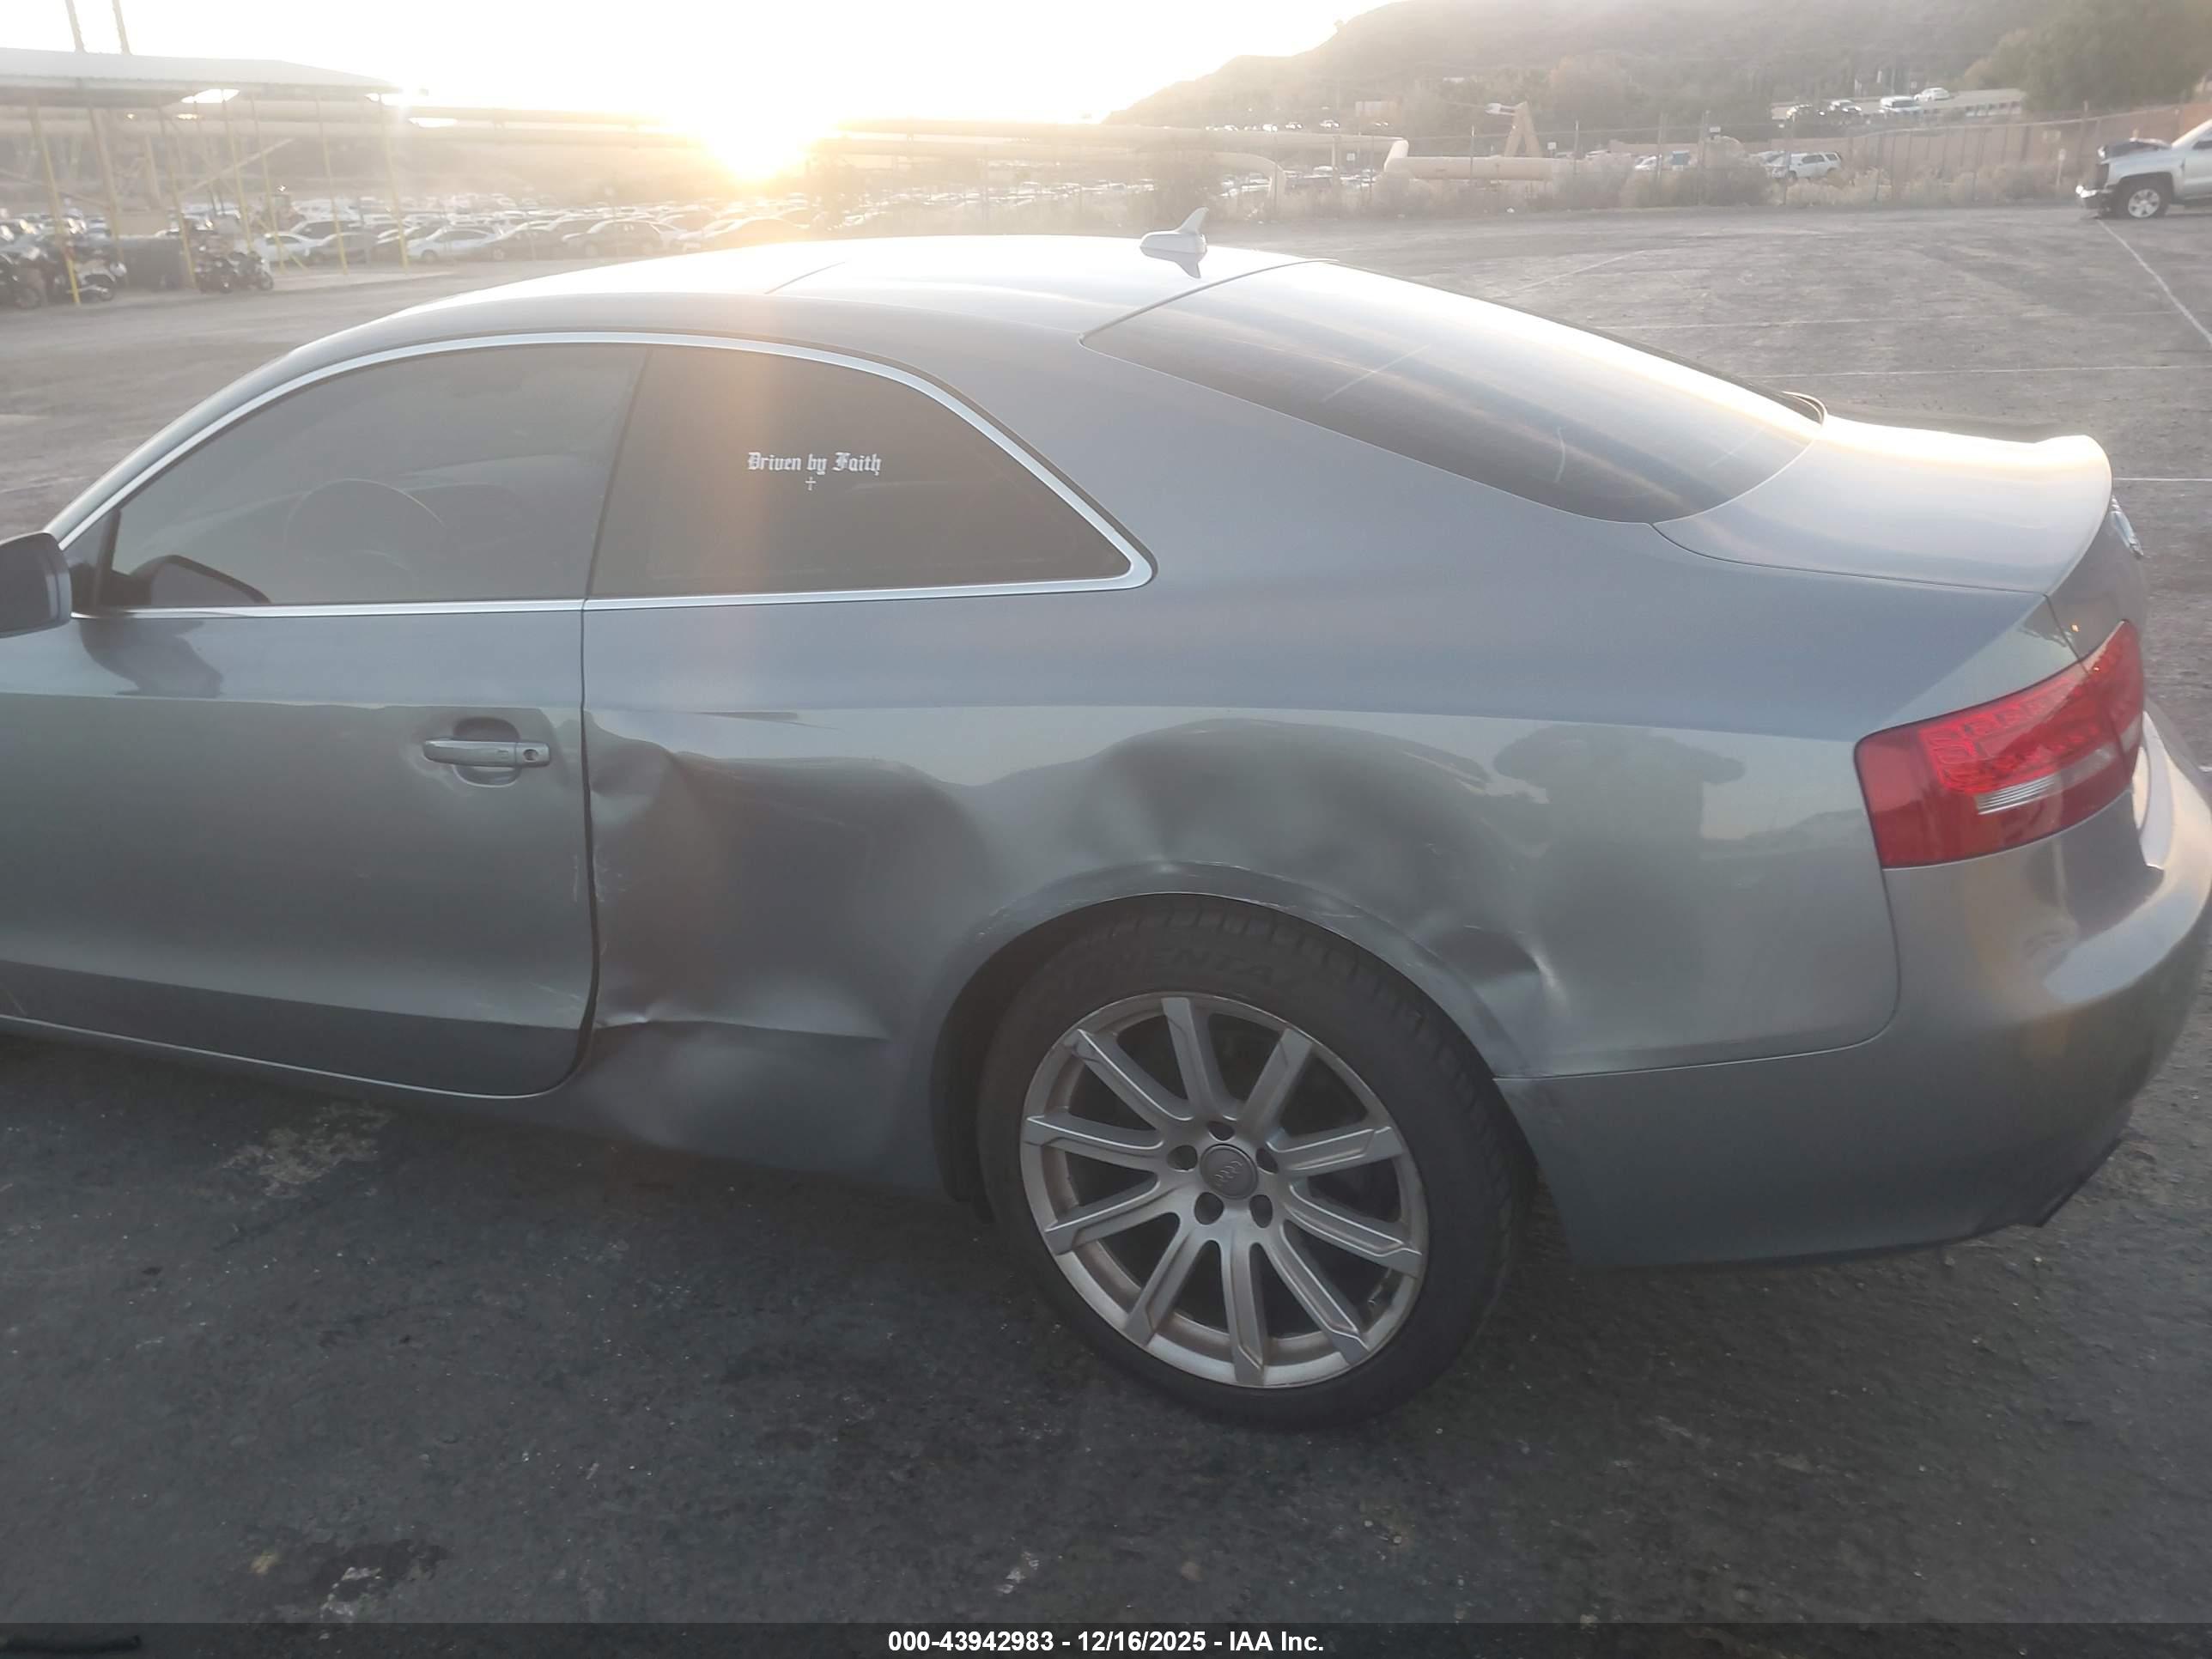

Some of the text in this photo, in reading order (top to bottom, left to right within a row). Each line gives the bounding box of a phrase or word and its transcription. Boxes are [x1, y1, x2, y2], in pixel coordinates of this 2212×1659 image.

[747, 452, 882, 476] Driven by Faith
